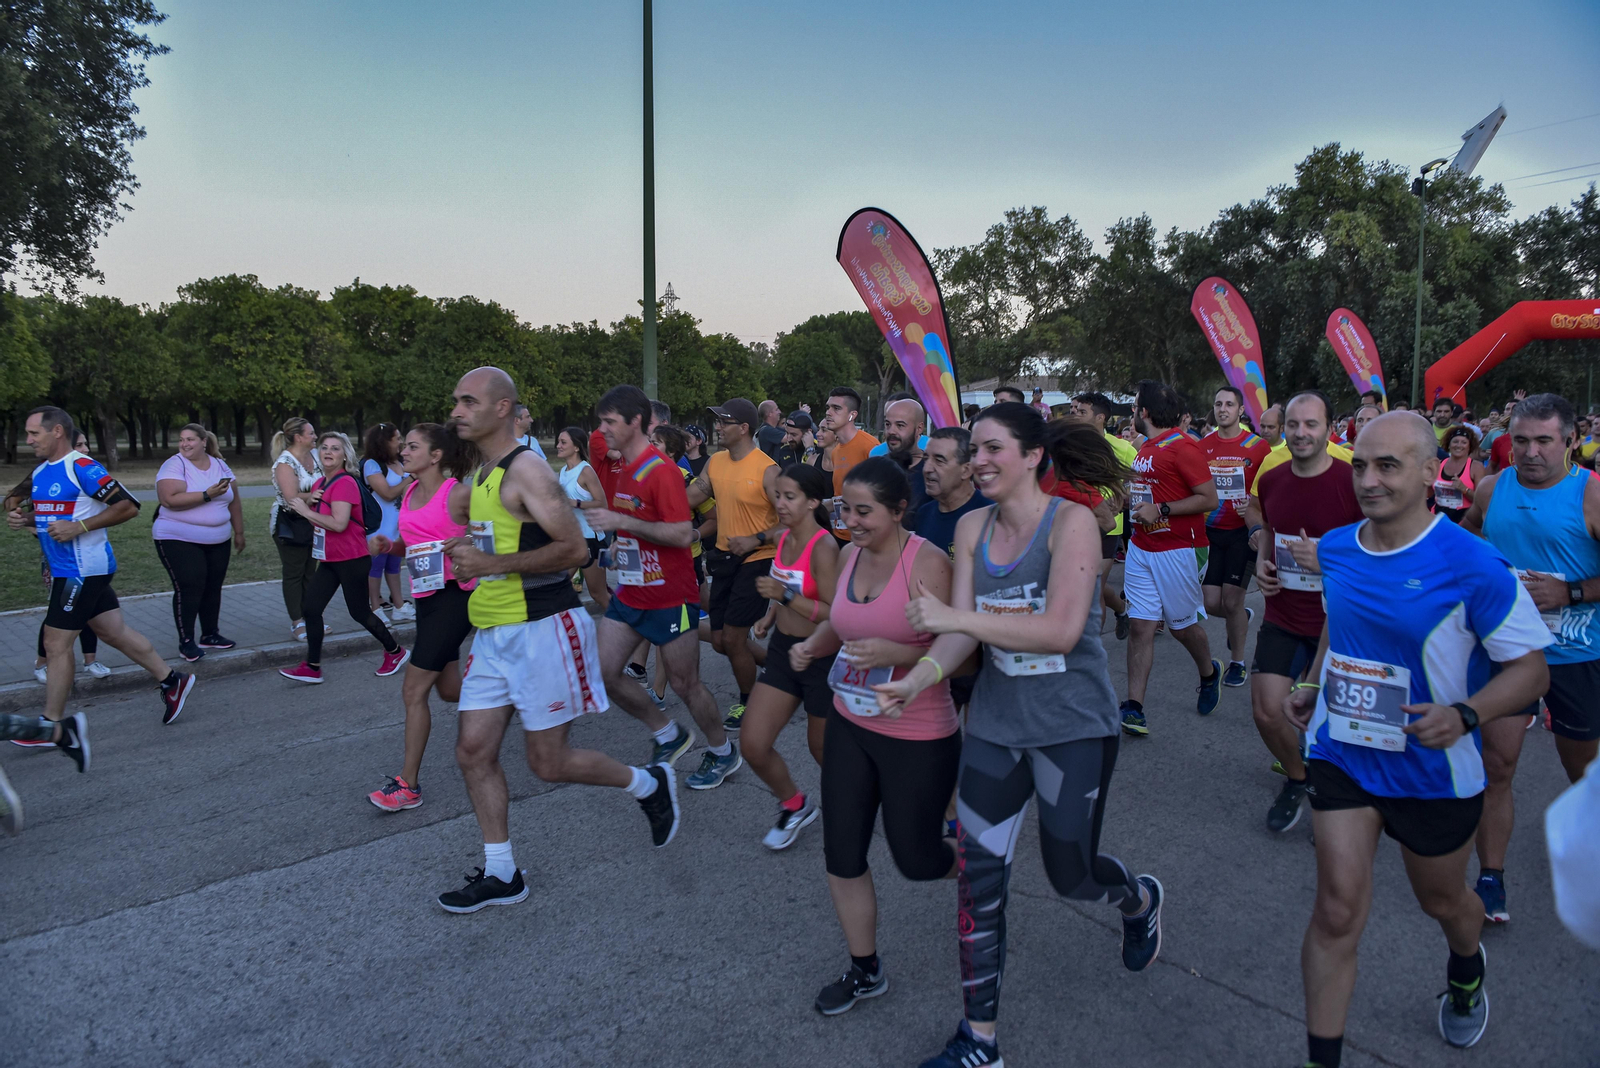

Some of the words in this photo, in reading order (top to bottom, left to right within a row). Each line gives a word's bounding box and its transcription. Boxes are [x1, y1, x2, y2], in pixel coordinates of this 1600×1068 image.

[1551, 313, 1579, 329] City
[1216, 476, 1233, 486] 539
[640, 549, 659, 563] UN
[843, 664, 870, 687] 237
[1335, 680, 1377, 710] 359
